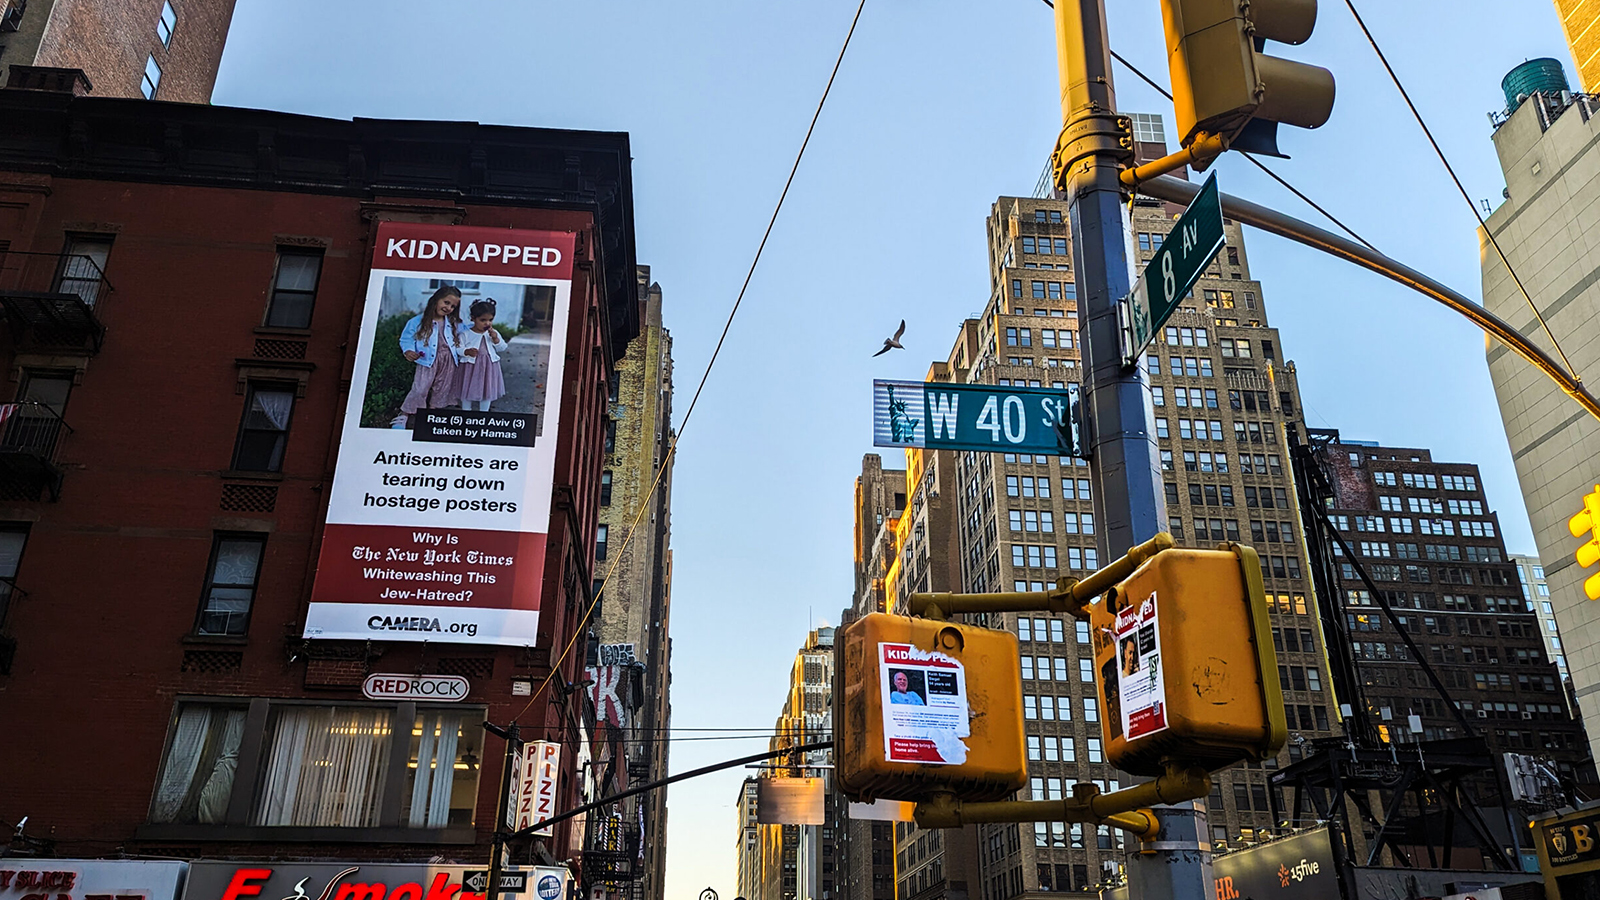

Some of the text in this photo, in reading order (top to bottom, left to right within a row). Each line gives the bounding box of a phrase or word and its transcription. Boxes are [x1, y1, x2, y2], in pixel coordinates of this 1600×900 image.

[386, 238, 562, 267] KIDNAPPED
[1162, 219, 1198, 303] 8 Av
[427, 414, 526, 430] Raz (5) and Aviv (3)
[928, 392, 1066, 444] W 40 St
[432, 426, 518, 439] taken by Hamas
[373, 450, 519, 471] Antisemites are
[382, 472, 505, 491] tearing down
[363, 492, 517, 513] hostage posters
[412, 532, 459, 546] Why Is
[352, 546, 514, 567] The New York Times
[363, 568, 497, 585] Whitewashing This
[380, 587, 473, 602] Jew-Hatred?
[372, 680, 461, 696] REDROCK
[519, 745, 537, 831] PIZZA
[538, 745, 556, 832] PIZZA
[15, 870, 77, 890] SLICE
[1290, 858, 1320, 882] 15five
[1215, 875, 1240, 900] HR.
